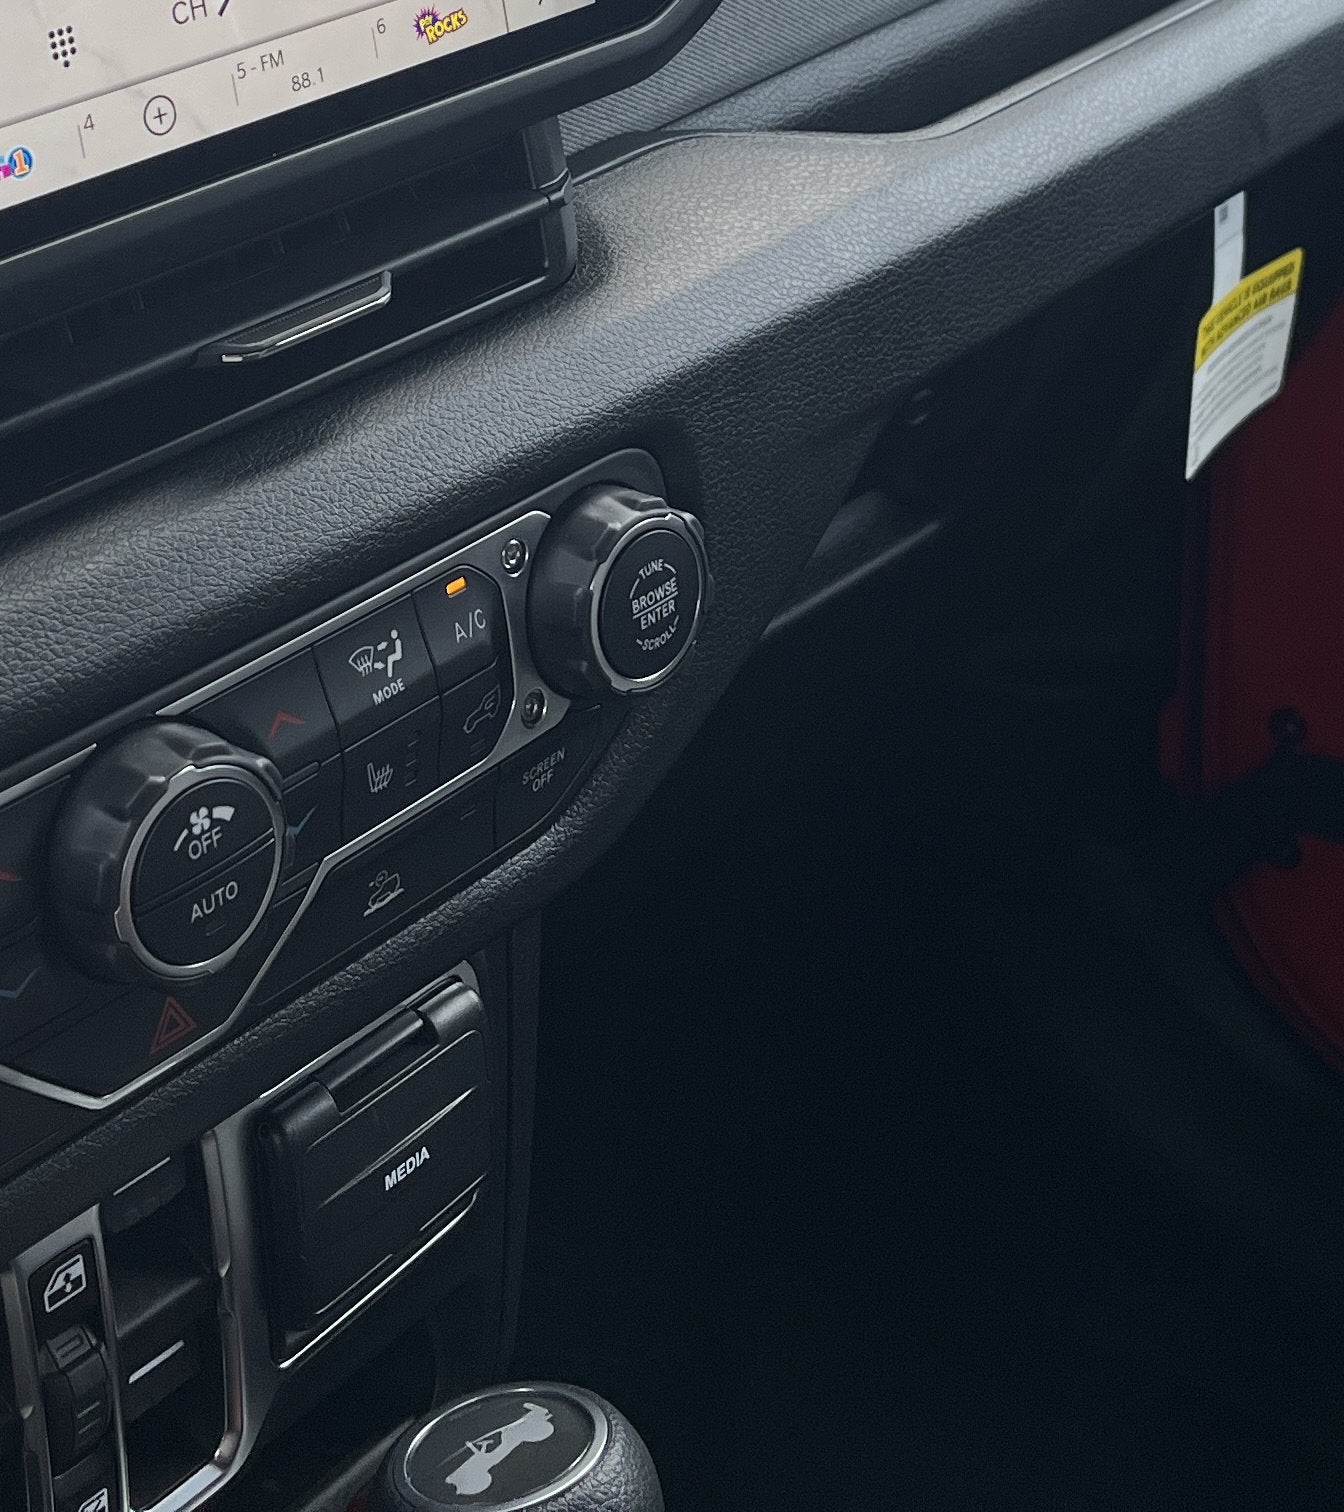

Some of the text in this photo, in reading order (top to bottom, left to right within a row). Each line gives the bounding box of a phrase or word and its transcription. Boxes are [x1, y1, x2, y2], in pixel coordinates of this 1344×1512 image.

[375, 17, 388, 36] 6
[424, 8, 468, 45] ROCKS
[235, 61, 248, 81] 5
[291, 66, 326, 93] 88.1
[82, 113, 96, 133] 4
[13, 149, 30, 176] 1
[638, 558, 665, 580] TUNE
[631, 576, 679, 615] BROWSE
[454, 606, 487, 644] A/C
[640, 599, 676, 631] ENTER
[641, 625, 676, 651] SCROLL
[372, 677, 406, 707] MODE
[521, 746, 566, 785] SCREEN
[532, 768, 554, 792] OFF
[188, 826, 223, 861] OFF
[190, 880, 240, 923] AUTO
[383, 1144, 431, 1192] MEDIA
